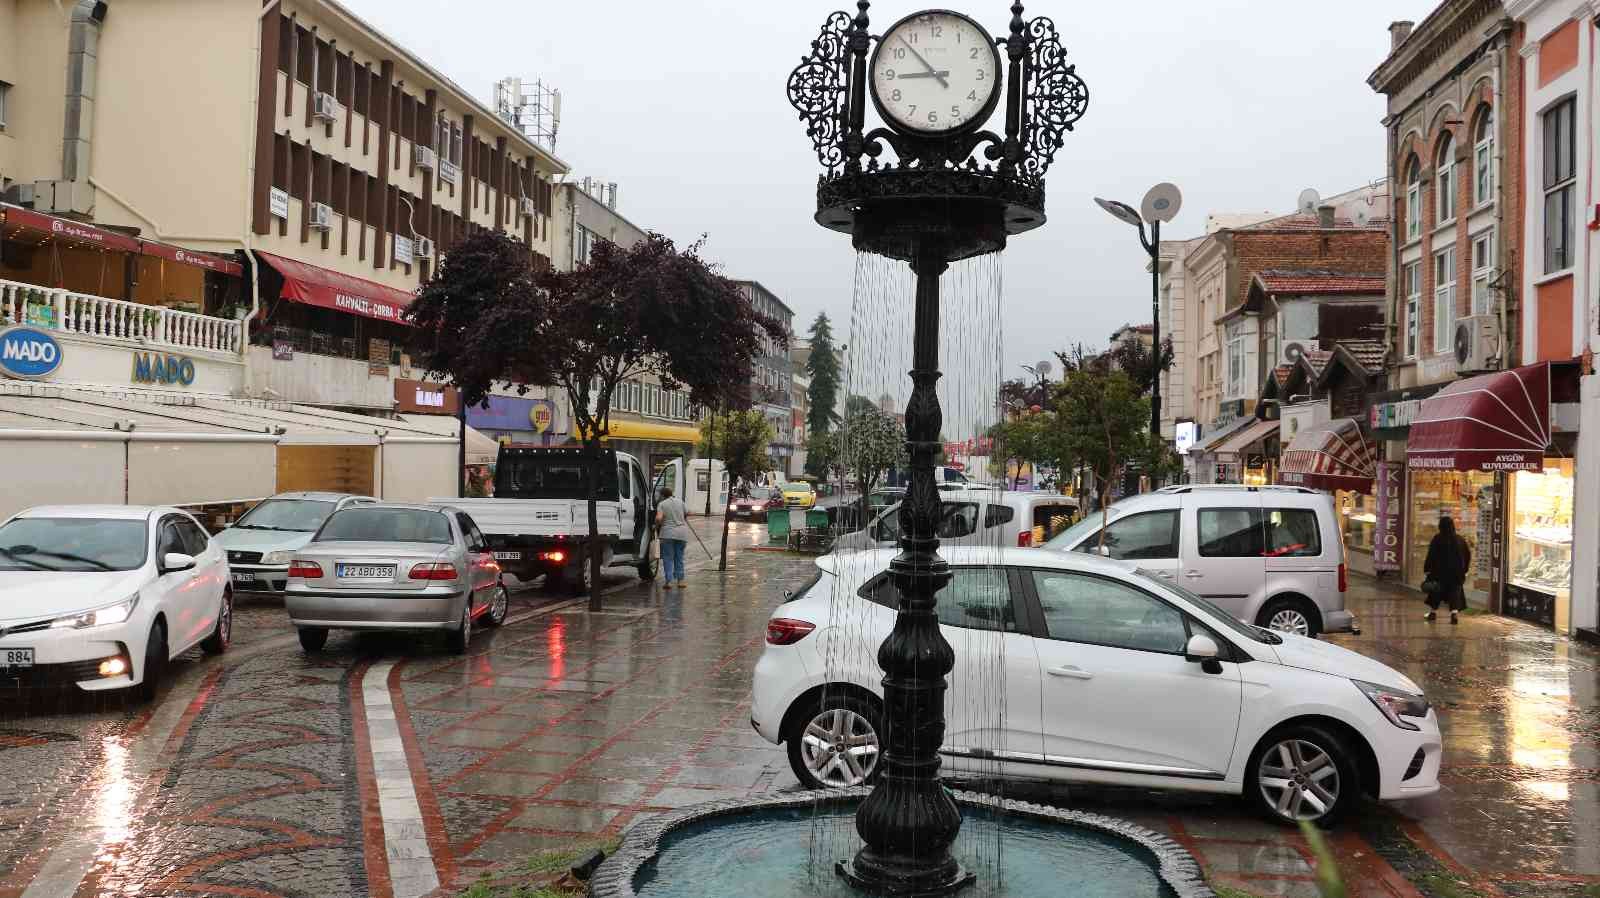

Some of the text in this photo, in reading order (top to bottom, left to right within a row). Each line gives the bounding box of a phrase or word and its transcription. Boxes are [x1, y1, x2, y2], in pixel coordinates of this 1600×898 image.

[931, 26, 942, 38] 12
[894, 48, 906, 59] 10
[970, 48, 978, 59] 2
[886, 69, 896, 80] 9
[976, 69, 985, 81] 3
[891, 89, 902, 102] 8
[967, 89, 977, 102] 4
[908, 105, 917, 116] 7
[951, 106, 960, 117] 5
[928, 111, 938, 122] 6
[2, 338, 56, 363] MADO
[131, 352, 195, 385] MADO
[1495, 453, 1525, 462] AYGÜN
[344, 567, 356, 577] 22
[376, 567, 393, 577] 358
[8, 651, 31, 663] 884
